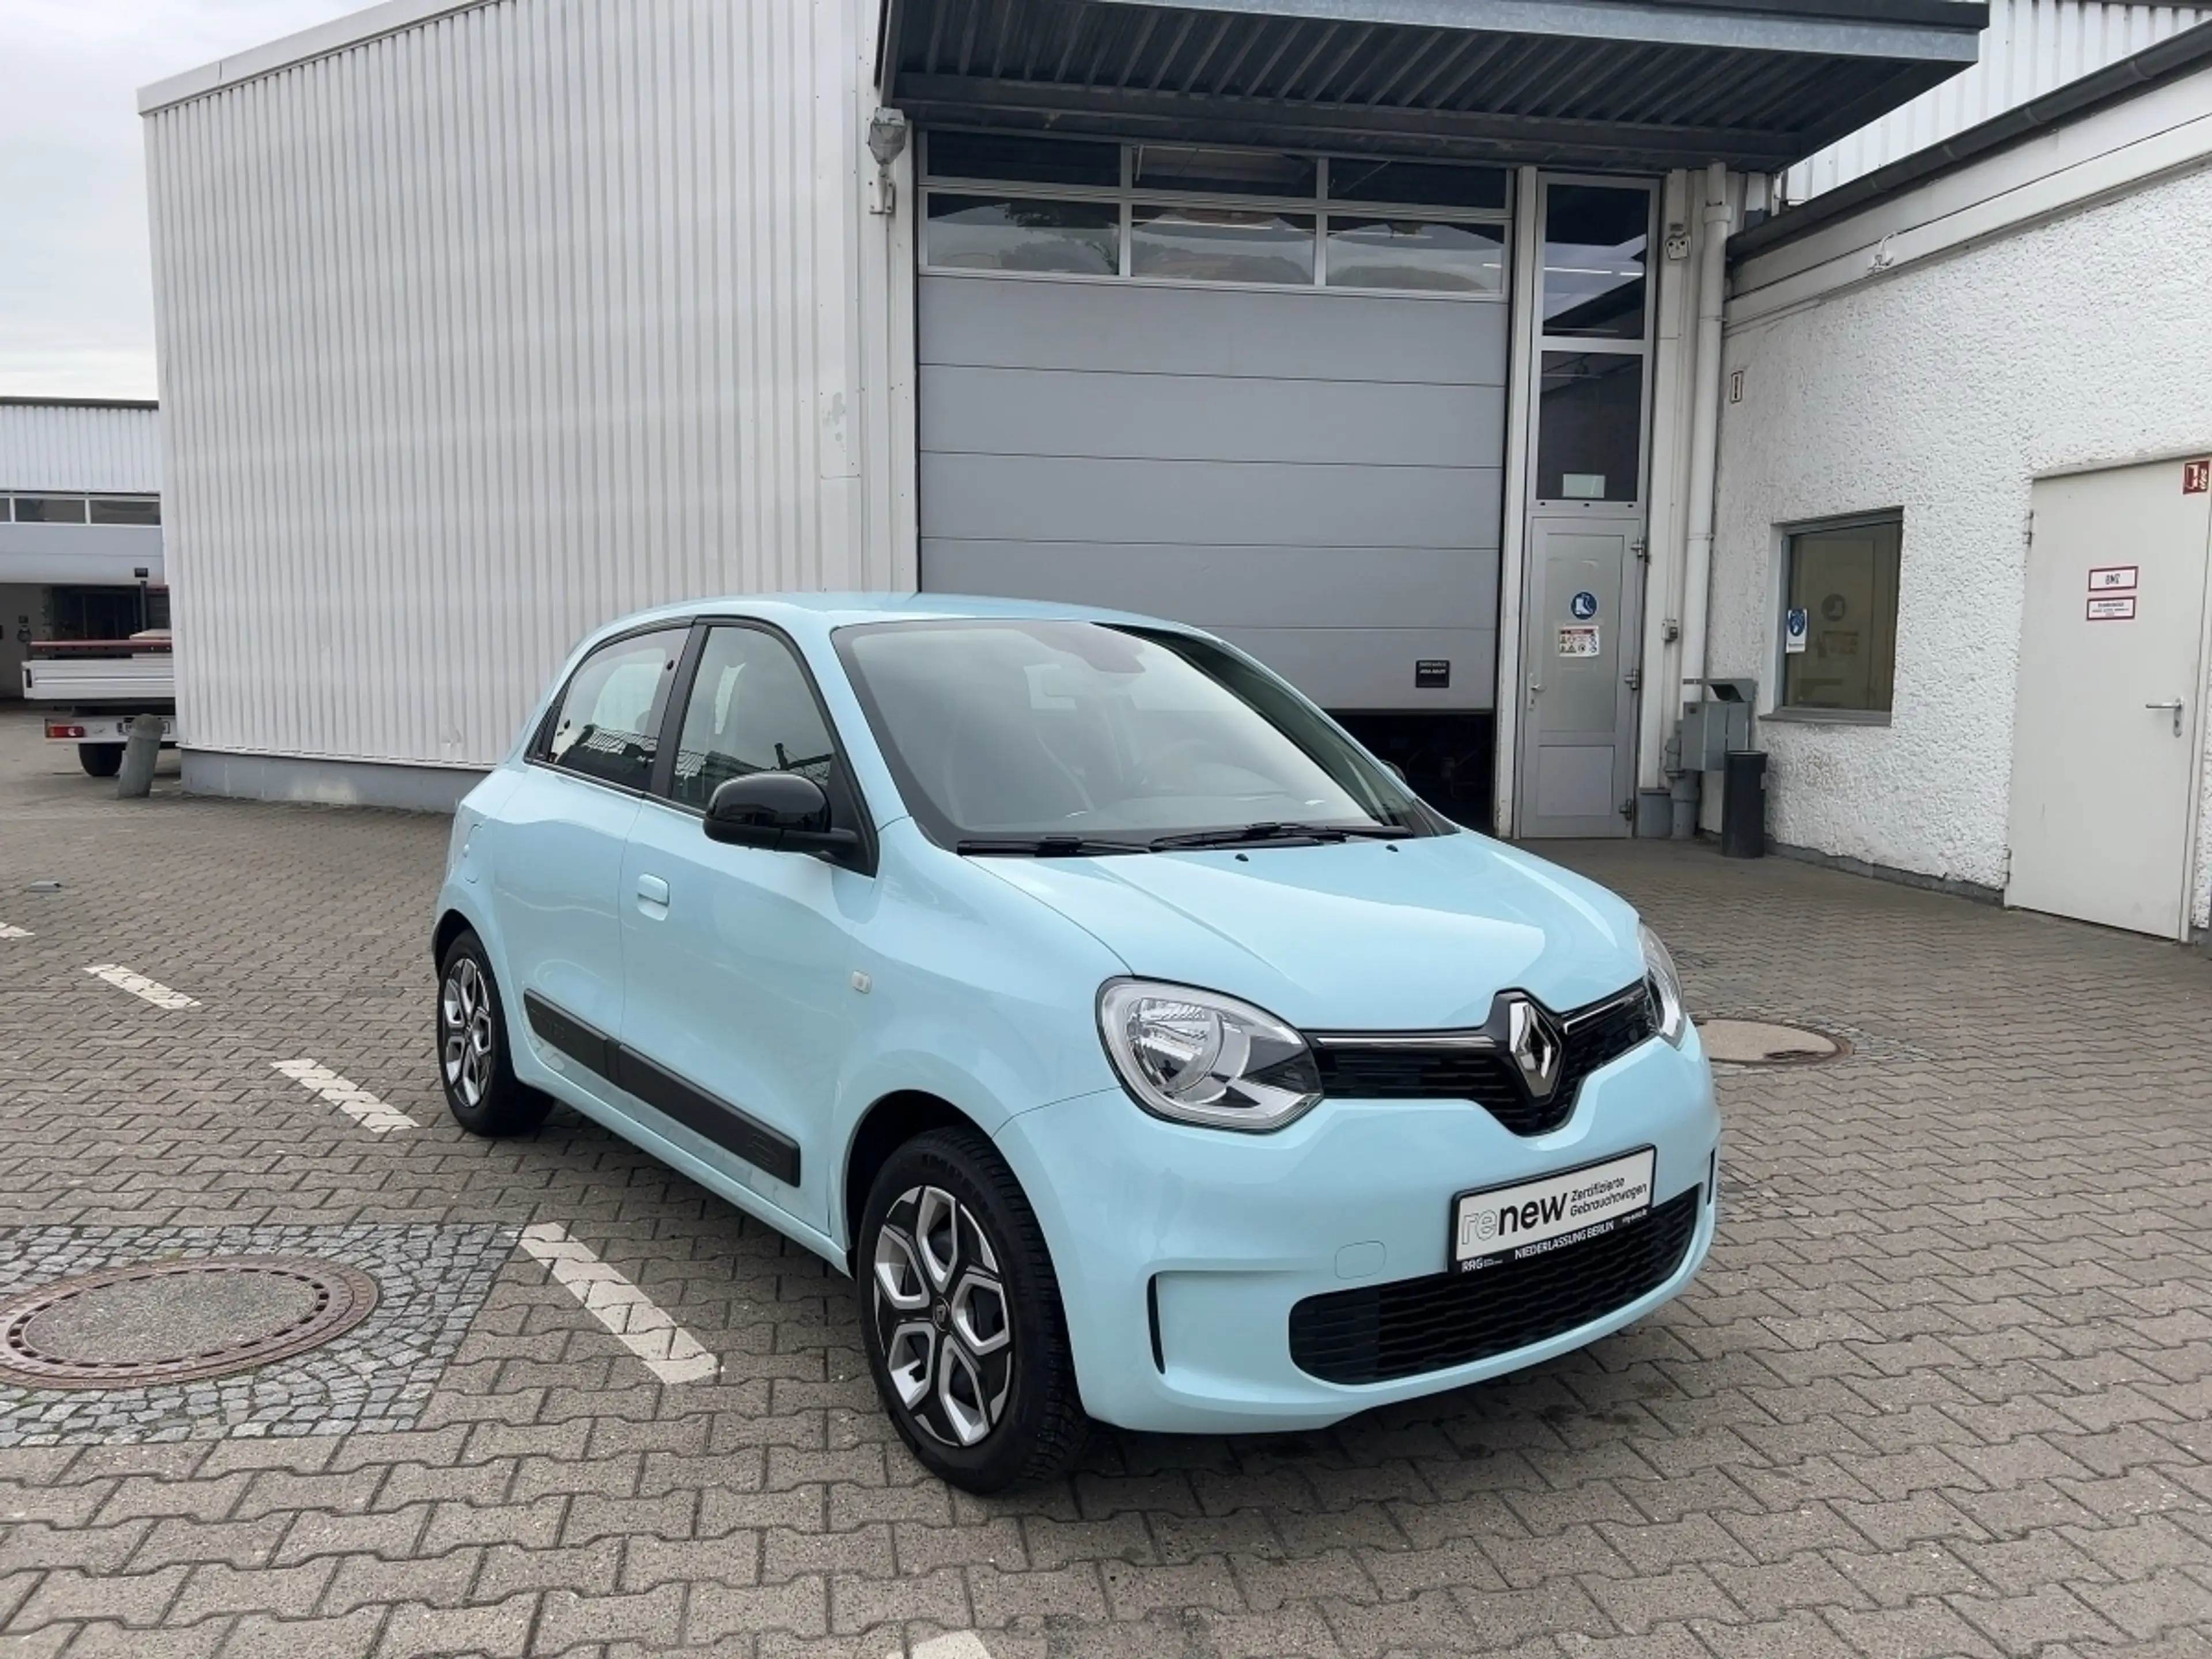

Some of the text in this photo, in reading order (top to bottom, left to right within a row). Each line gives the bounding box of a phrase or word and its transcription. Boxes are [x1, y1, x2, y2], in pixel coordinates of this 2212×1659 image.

[1570, 1177, 1626, 1202] Zertifizierte
[1570, 1183, 1647, 1217] Gebrauchtwagen
[1461, 1192, 1568, 1245] renew
[1514, 1220, 1615, 1260] NIEDERLASSUNG BERLIN
